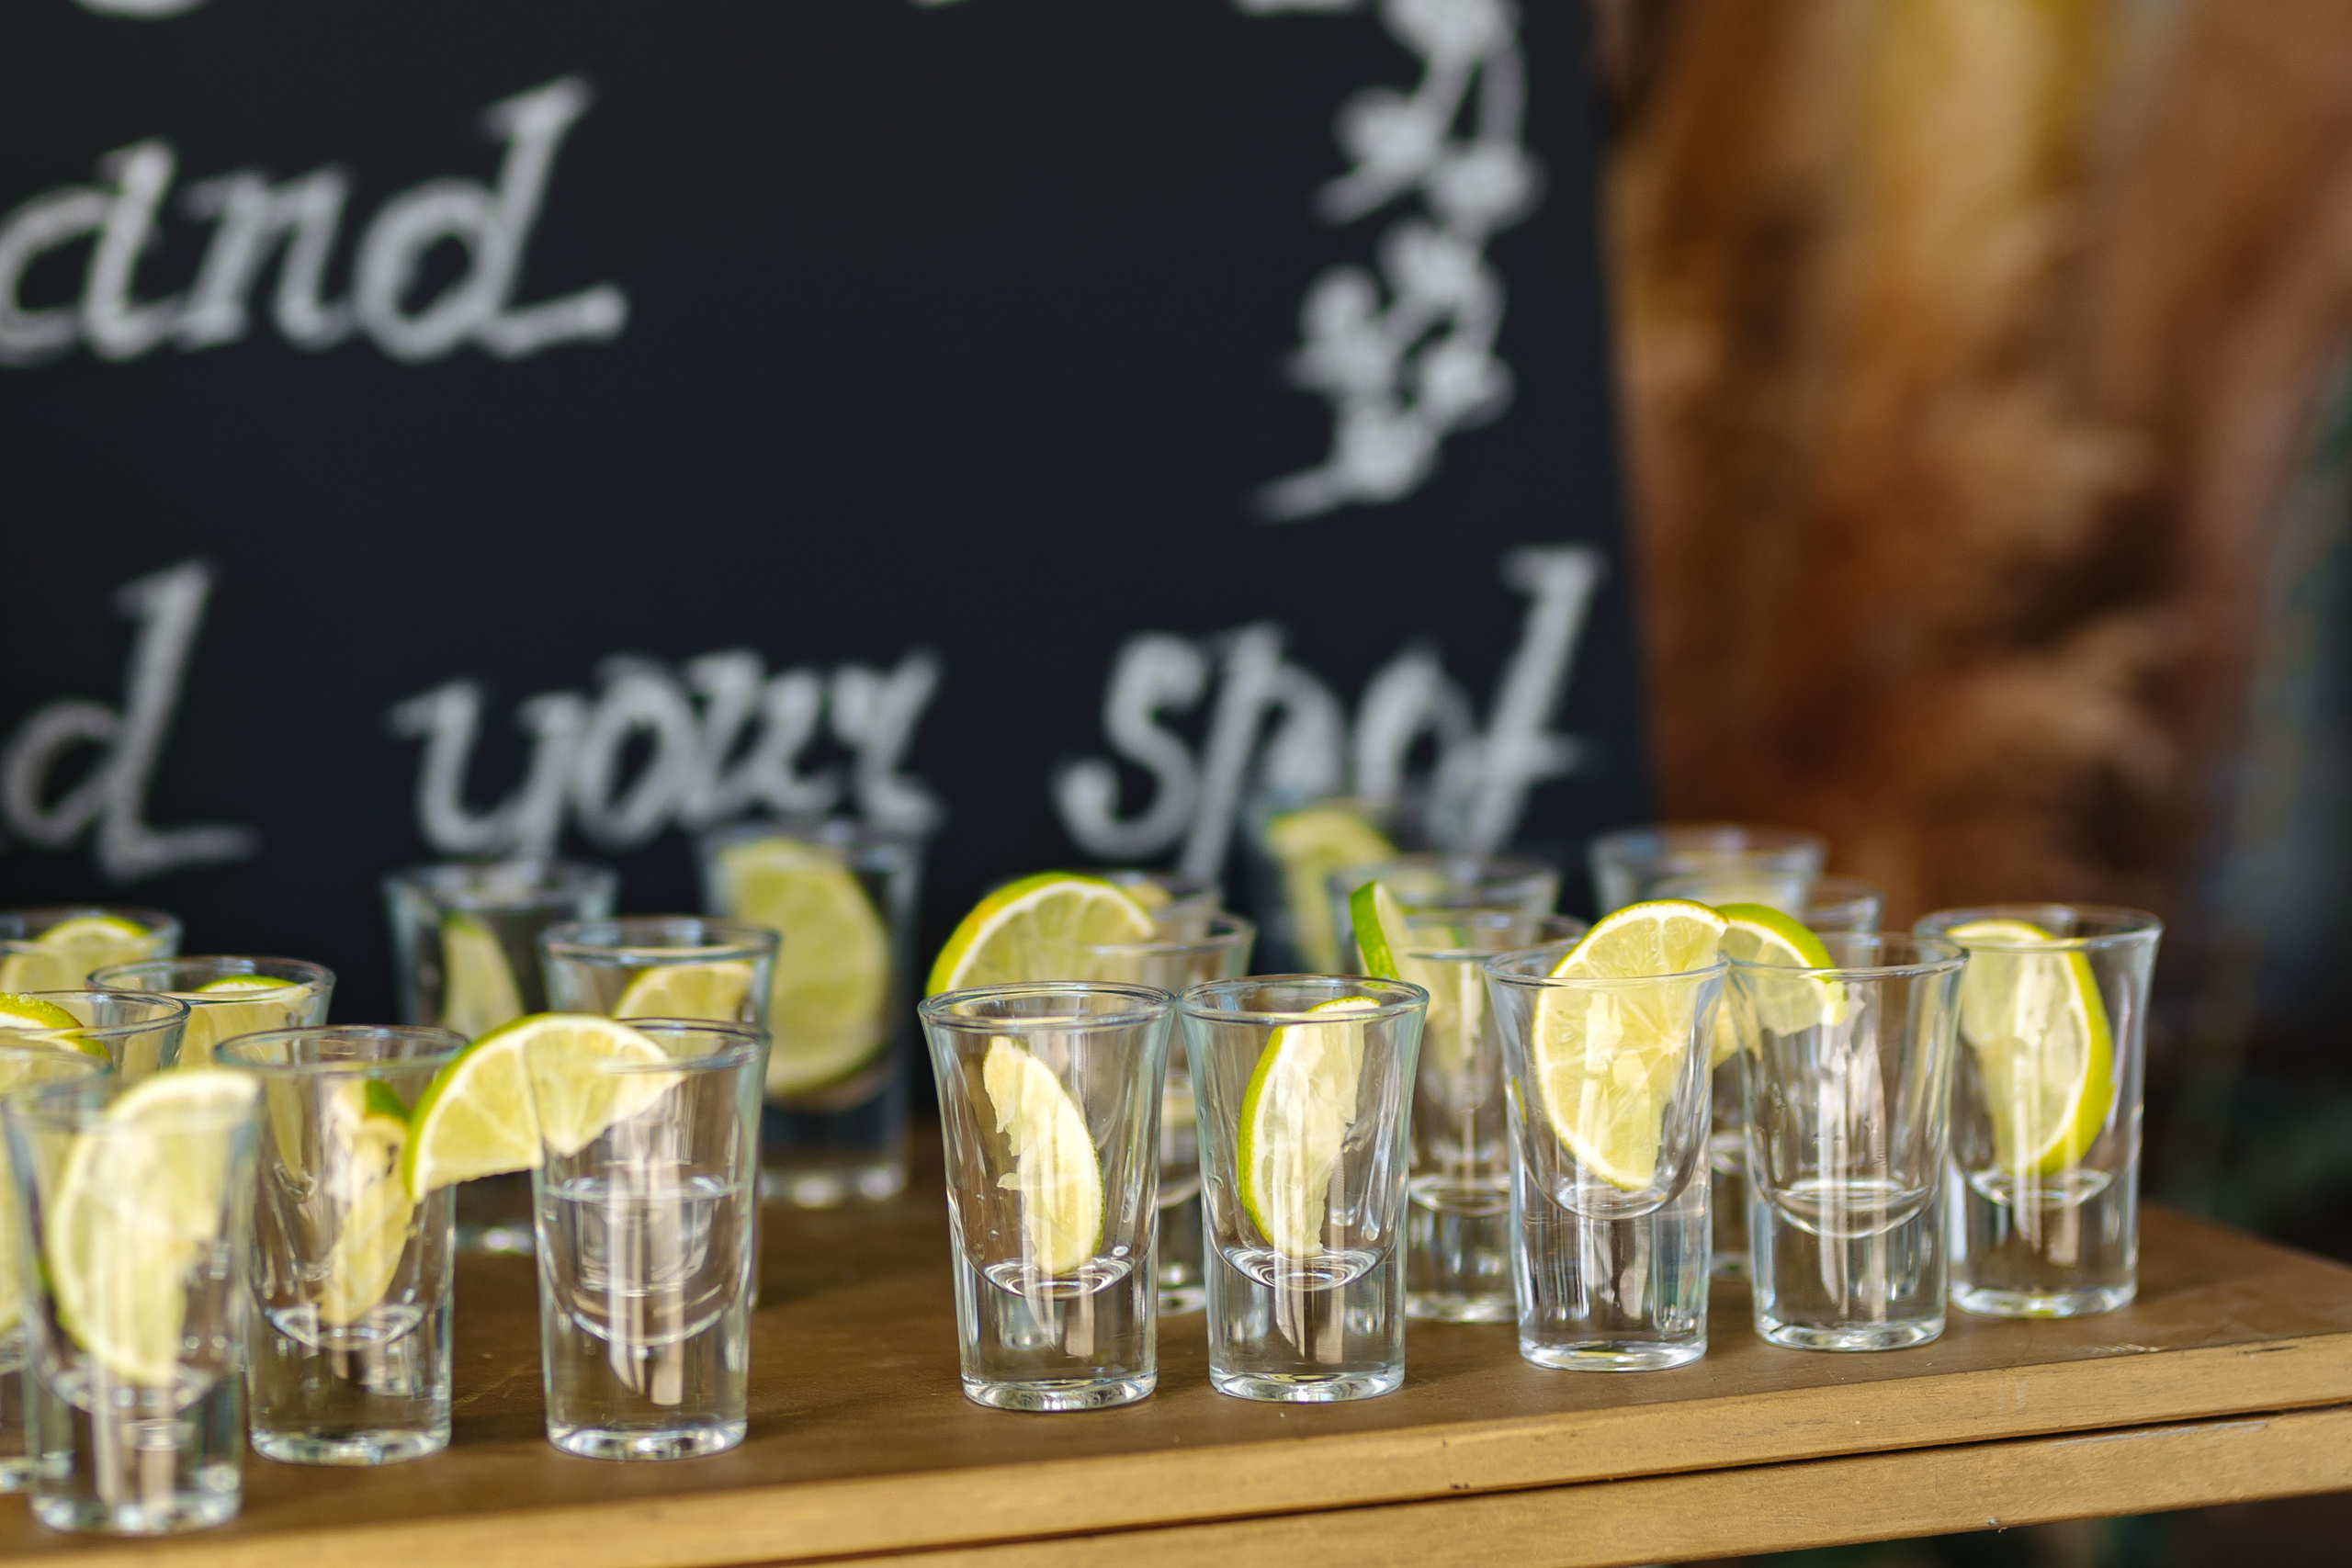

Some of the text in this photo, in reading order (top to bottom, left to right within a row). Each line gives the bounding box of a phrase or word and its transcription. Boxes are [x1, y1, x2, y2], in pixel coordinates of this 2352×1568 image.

[0, 77, 628, 362] and
[388, 650, 946, 865] your
[1052, 546, 1606, 886] spot
